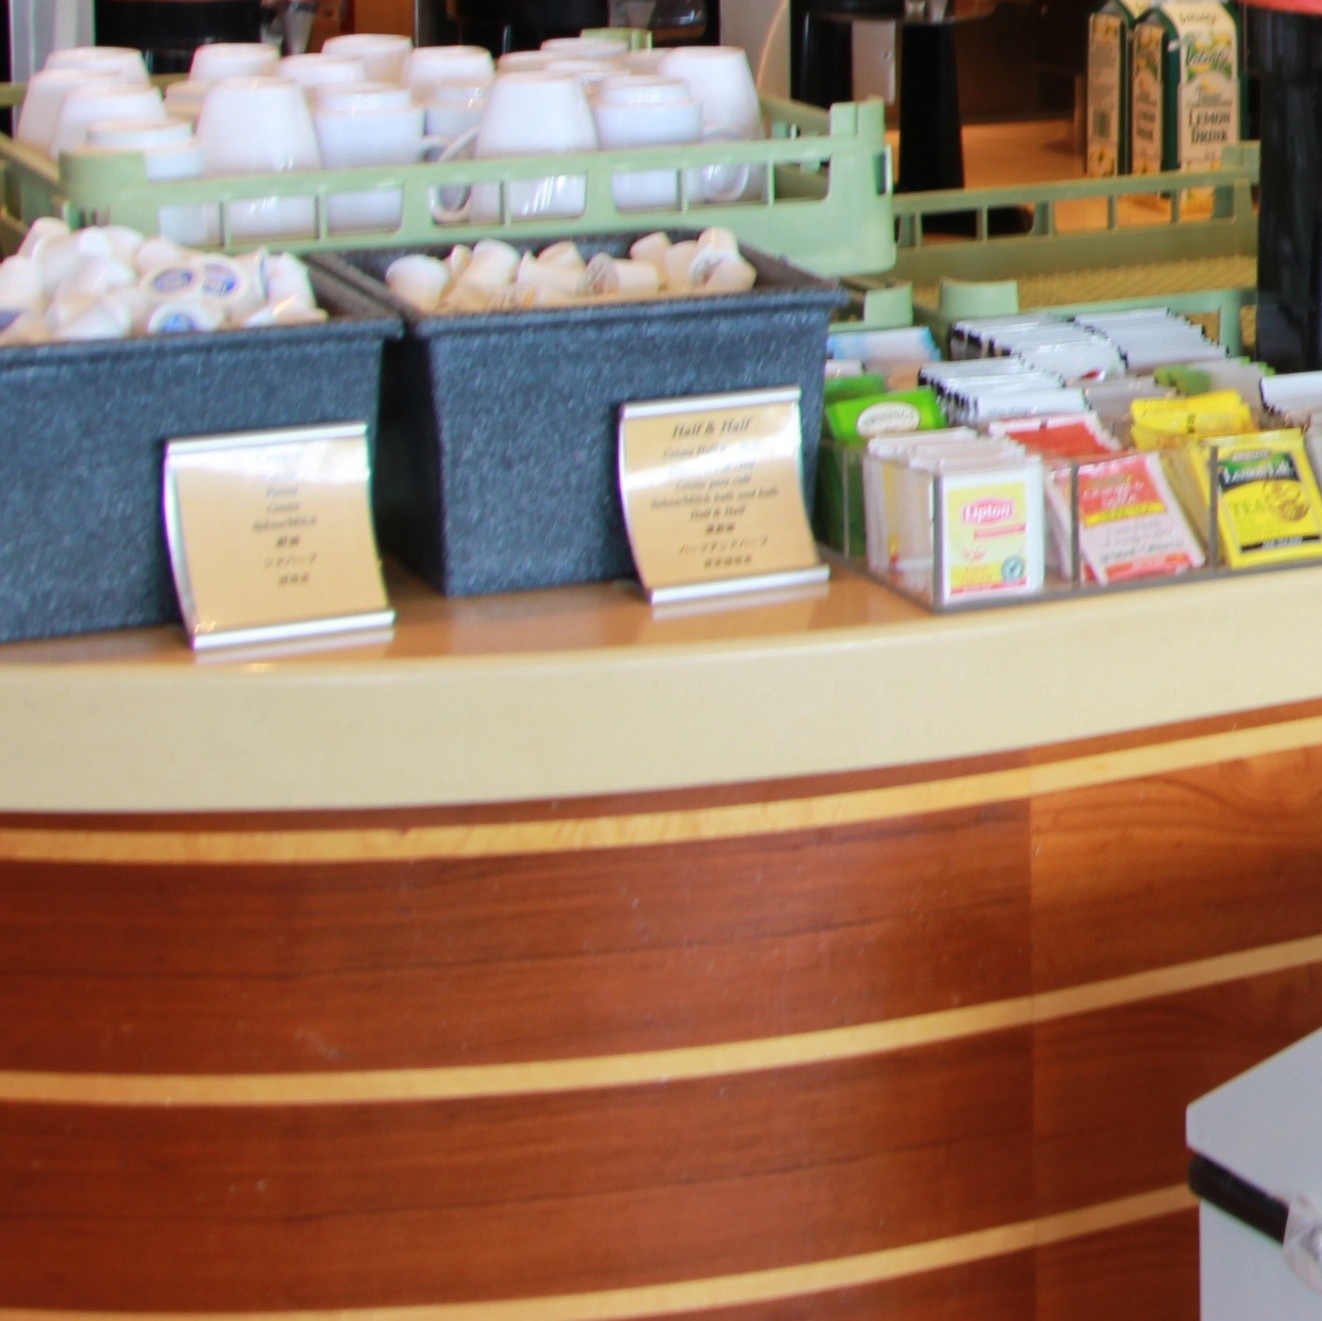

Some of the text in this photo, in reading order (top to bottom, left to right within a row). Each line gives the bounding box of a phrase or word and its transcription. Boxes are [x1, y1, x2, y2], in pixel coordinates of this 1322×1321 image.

[1186, 49, 1229, 67] Vitality
[672, 417, 753, 439] Half & Half
[965, 504, 1011, 523] Lipton
